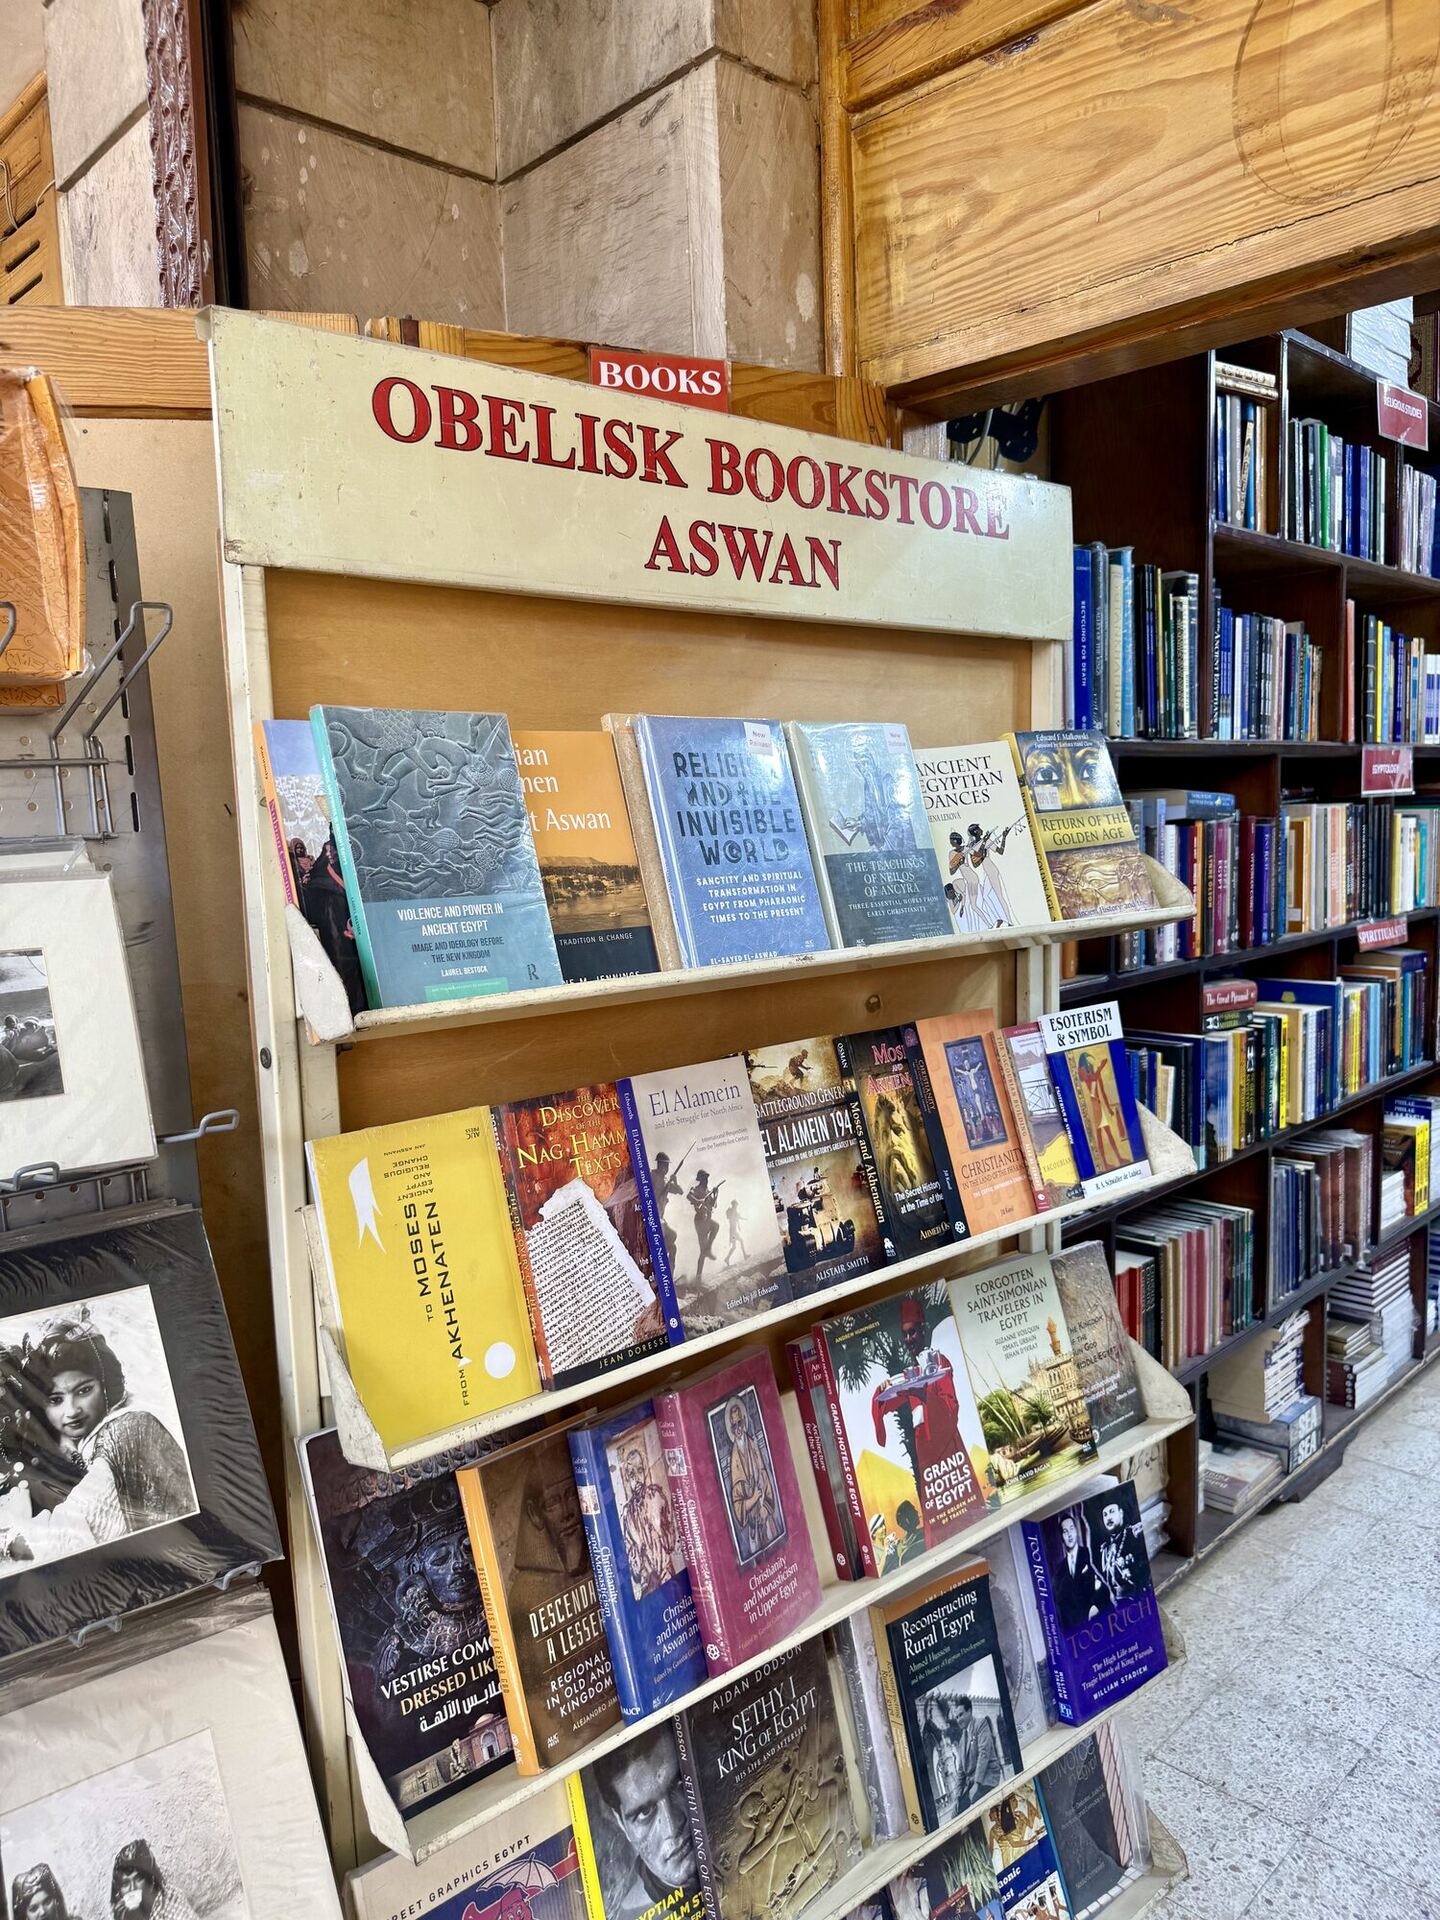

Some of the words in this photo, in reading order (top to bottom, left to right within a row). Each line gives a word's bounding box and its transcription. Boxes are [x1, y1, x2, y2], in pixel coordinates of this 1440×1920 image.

[599, 361, 722, 396] BOOKS
[372, 377, 688, 487] OBELISK
[706, 438, 1010, 539] BOOKSTORE
[645, 515, 841, 590] ASWAN
[514, 743, 548, 765] ian
[916, 755, 990, 776] ANCIENT
[685, 781, 732, 806] AND
[919, 771, 1003, 793] EGYPTIAN
[923, 789, 990, 809] DANCES
[528, 810, 540, 831] t
[546, 808, 611, 832] Aswan
[677, 809, 796, 836] INVISIBLE
[1042, 817, 1085, 832] RETURN
[1088, 815, 1102, 826] OF
[1105, 812, 1128, 823] THE
[1053, 829, 1098, 846] GOLDEN
[1103, 828, 1125, 839] AGE
[699, 838, 789, 865] WORLD
[846, 862, 868, 872] THE
[870, 857, 926, 871] TEACHINGS
[696, 874, 740, 886] SANCTITY
[742, 873, 759, 882] AND
[761, 871, 803, 882] SPIRITUAL
[708, 885, 785, 898] TRANSFORMATION
[788, 884, 796, 892] IN
[864, 874, 877, 884] OF
[880, 871, 914, 883] NEILOS
[865, 886, 878, 897] OF
[881, 883, 920, 895] ANCYRA
[397, 906, 442, 922] VIOLENCE
[444, 906, 462, 918] AND
[463, 904, 492, 917] POWER
[493, 902, 504, 914] IN
[703, 901, 731, 912] EGYPT
[733, 899, 757, 910] FROM
[759, 896, 806, 907] PHARAONIC
[710, 914, 736, 923] TIMES
[739, 912, 750, 921] TO
[752, 910, 768, 920] THE
[770, 908, 804, 918] PRESENT
[421, 922, 459, 936] ANCIENT
[461, 920, 488, 934] EGYPT
[560, 937, 595, 946] TRADITION
[606, 933, 633, 941] CHANGE
[432, 954, 444, 964] THE
[445, 953, 461, 963] NEW
[462, 950, 490, 961] KINGDOM
[1050, 1008, 1113, 1032] ESOTERISM
[1057, 1033, 1067, 1047] &
[1068, 1024, 1112, 1046] SYMBOL
[836, 1042, 848, 1069] OSMAN
[1000, 1052, 1018, 1098] YACOUBIAN
[624, 1092, 634, 1120] Edwards
[648, 1089, 669, 1117] El
[674, 1079, 741, 1112] Alamein
[754, 1092, 816, 1119] BATTLEGROUND
[539, 1097, 620, 1127] DISCOVER
[850, 1101, 864, 1137] Moses
[631, 1128, 637, 1137] El
[760, 1129, 776, 1157] EL
[778, 1115, 830, 1153] ALAMEIN
[830, 1109, 853, 1138] 194
[392, 1155, 428, 1168] CHANGE
[517, 1144, 563, 1168] NAG
[570, 1130, 627, 1156] HAMM
[633, 1137, 644, 1168] Alamein
[859, 1138, 873, 1161] and
[384, 1164, 430, 1179] RELIGIOUS
[413, 1172, 431, 1180] AND
[570, 1152, 622, 1177] TEXTS
[639, 1170, 648, 1184] and
[397, 1188, 434, 1201] ANCIENT
[406, 1180, 433, 1190] EGYPT
[642, 1185, 650, 1198] the
[865, 1164, 885, 1223] Akhenaten
[894, 1192, 905, 1201] The
[905, 1187, 922, 1198] Secret
[922, 1181, 941, 1192] History
[646, 1199, 658, 1232] Struggle
[901, 1205, 907, 1214] at
[907, 1202, 915, 1212] the
[915, 1198, 929, 1208] Time
[929, 1194, 935, 1203] of
[935, 1193, 944, 1202] the
[404, 1203, 432, 1297] MOSES
[656, 1247, 665, 1270] North
[425, 1202, 464, 1360] AKHENATEN
[815, 1266, 846, 1282] ALISTAIR
[847, 1255, 870, 1274] SMITH
[975, 1267, 1034, 1296] FORGOTTEN
[661, 1270, 670, 1297] Africa
[967, 1277, 1048, 1314] SAINT-SIMONIAN
[426, 1304, 434, 1322] TO
[978, 1298, 1031, 1325] TRAVELERS
[1033, 1293, 1045, 1305] IN
[1000, 1312, 1028, 1332] EGYPT
[598, 1352, 624, 1369] JEAN
[628, 1336, 669, 1359] DORESSE
[459, 1368, 470, 1406] FROM
[805, 1422, 813, 1435] for
[808, 1437, 816, 1452] the
[812, 1422, 827, 1472] Architecture
[812, 1452, 820, 1470] Poor
[830, 1402, 842, 1435] GRAND
[838, 1436, 850, 1473] HOTELS
[844, 1474, 852, 1487] OF
[849, 1489, 861, 1518] EGYPT
[924, 1452, 965, 1482] GRAND
[925, 1464, 970, 1499] HOTELS
[925, 1499, 935, 1510] OF
[935, 1479, 972, 1510] EGYPT
[749, 1555, 787, 1591] Christianity
[1027, 1535, 1041, 1562] TOO
[1034, 1566, 1048, 1597] RICH
[743, 1595, 758, 1612] and
[757, 1562, 798, 1601] Monasticism
[749, 1612, 758, 1624] in
[757, 1593, 779, 1617] Upper
[779, 1577, 798, 1600] Egypt
[529, 1580, 597, 1638] DESCENDA
[901, 1590, 977, 1639] Reconstructing
[904, 1625, 938, 1659] Rural
[940, 1609, 975, 1638] Egypt
[1066, 1622, 1104, 1659] TOO
[1108, 1598, 1152, 1637] RICH
[547, 1636, 557, 1664] A
[653, 1652, 662, 1665] in
[662, 1631, 688, 1659] Aswan
[688, 1624, 699, 1638] an
[380, 1655, 449, 1700] VESTIRSE
[550, 1650, 606, 1692] REGIONAL
[712, 1682, 750, 1713] AIDAN
[755, 1644, 803, 1683] DODSON
[1093, 1680, 1119, 1700] WILLIAM
[1121, 1665, 1148, 1684] STADIEM
[400, 1672, 466, 1716] DRESSED
[546, 1696, 561, 1710] IN
[564, 1678, 586, 1699] OLD
[590, 1661, 612, 1685] AND
[559, 1676, 613, 1718] KINGDOM
[572, 1702, 607, 1732] ALEJANDRO
[623, 1707, 641, 1715] AUCP
[732, 1682, 786, 1742] SETHY
[789, 1675, 796, 1699] I
[716, 1734, 756, 1780] KING
[758, 1727, 773, 1748] OF
[773, 1686, 817, 1738] EGYPT
[387, 1899, 422, 1920] REET
[429, 1860, 489, 1901] GRAPHICS
[495, 1835, 531, 1863] EGYPT
